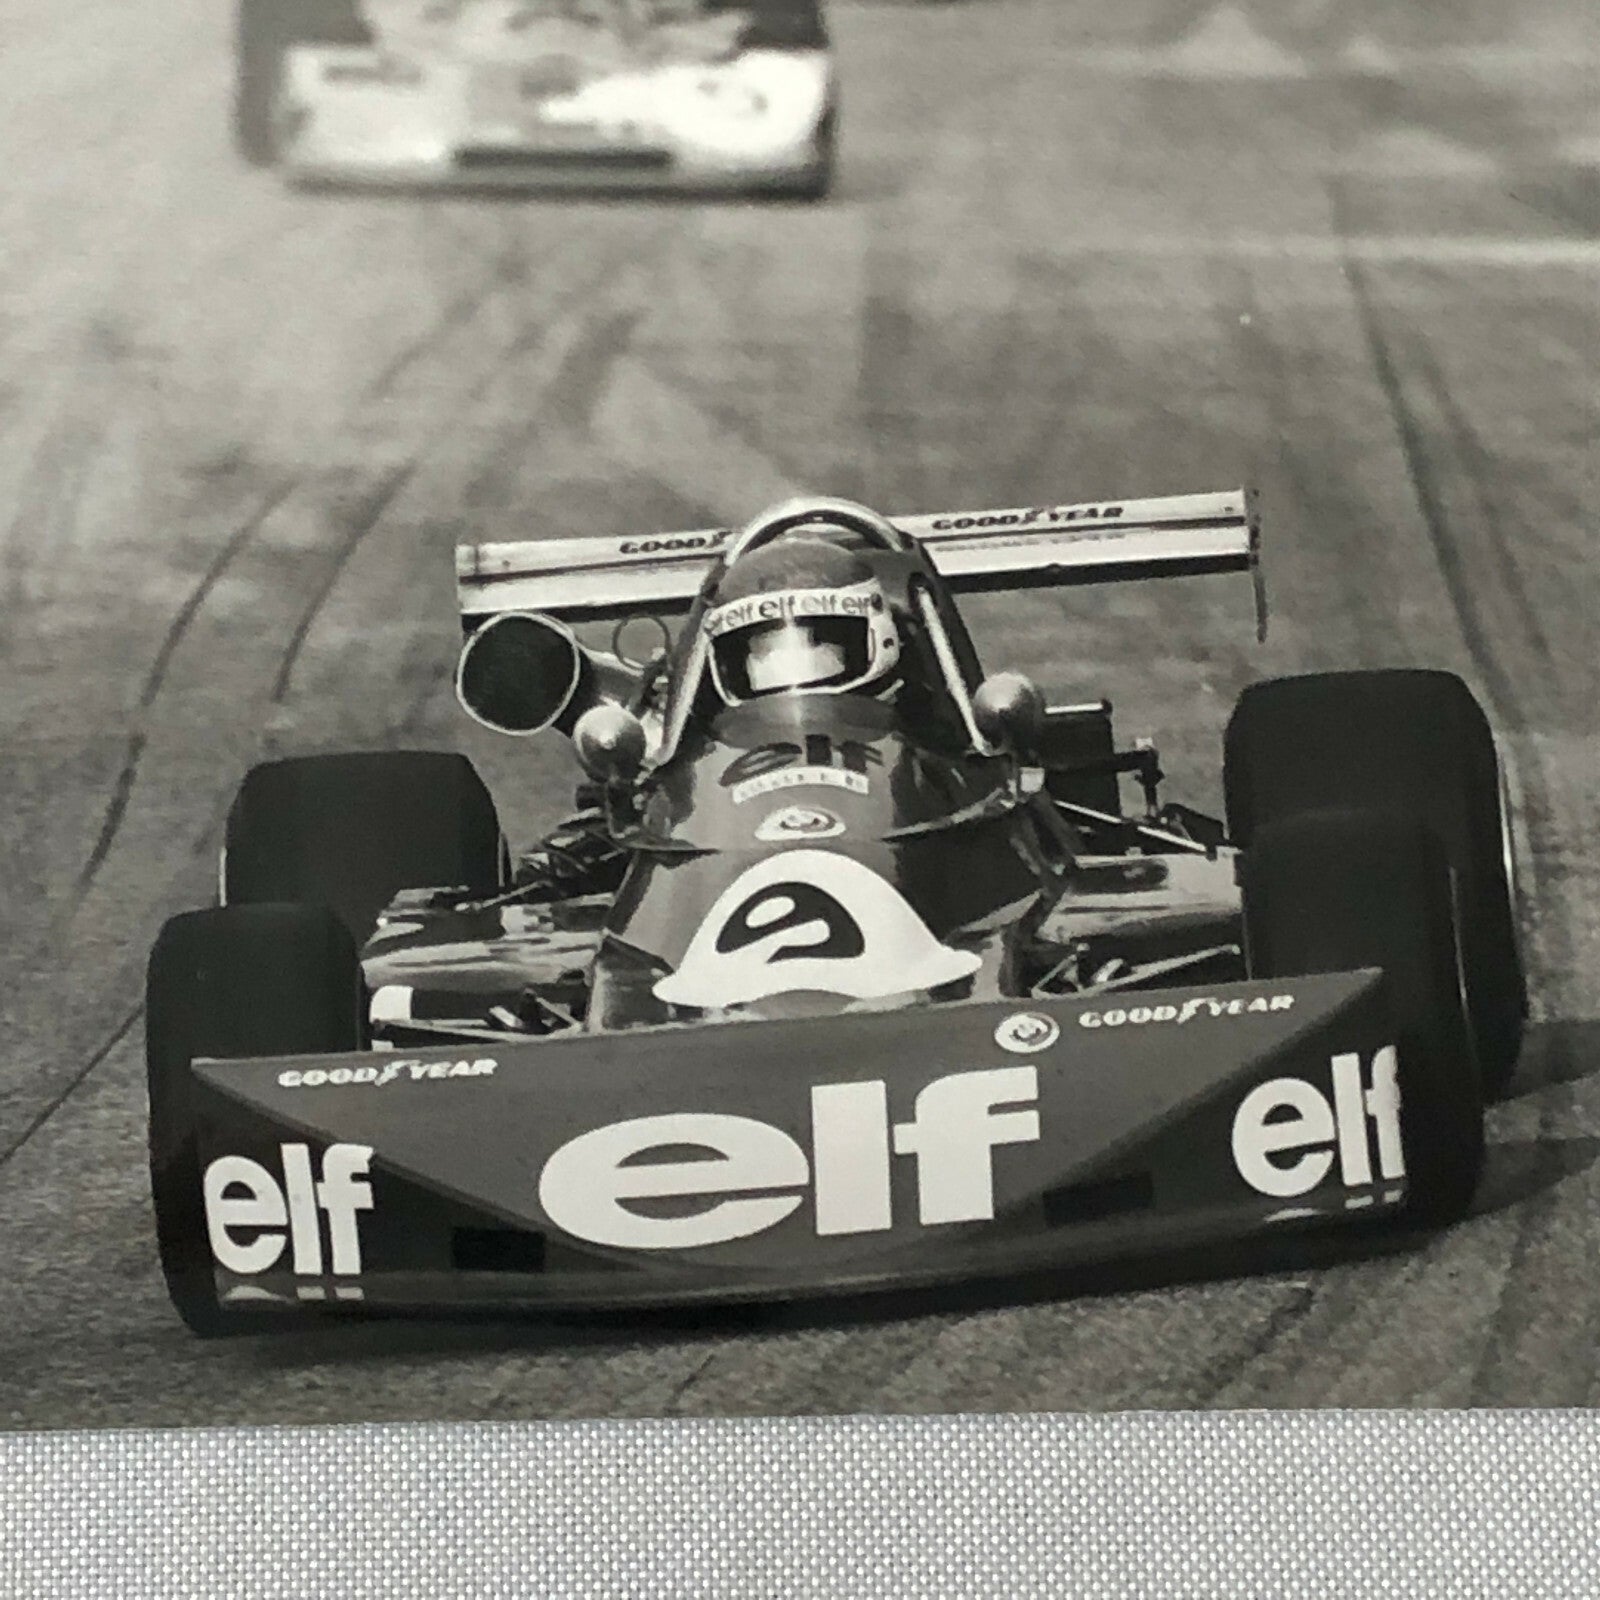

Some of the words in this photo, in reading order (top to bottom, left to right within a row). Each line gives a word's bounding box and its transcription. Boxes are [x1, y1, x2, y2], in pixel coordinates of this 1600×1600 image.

[758, 594, 796, 619] elf
[801, 594, 837, 614] elf
[1078, 995, 1295, 1028] GOODYEAR
[277, 1058, 499, 1087] GOODYEAR
[539, 1065, 1041, 1249] elf
[1231, 1044, 1406, 1197] elf
[203, 1143, 374, 1275] elf
